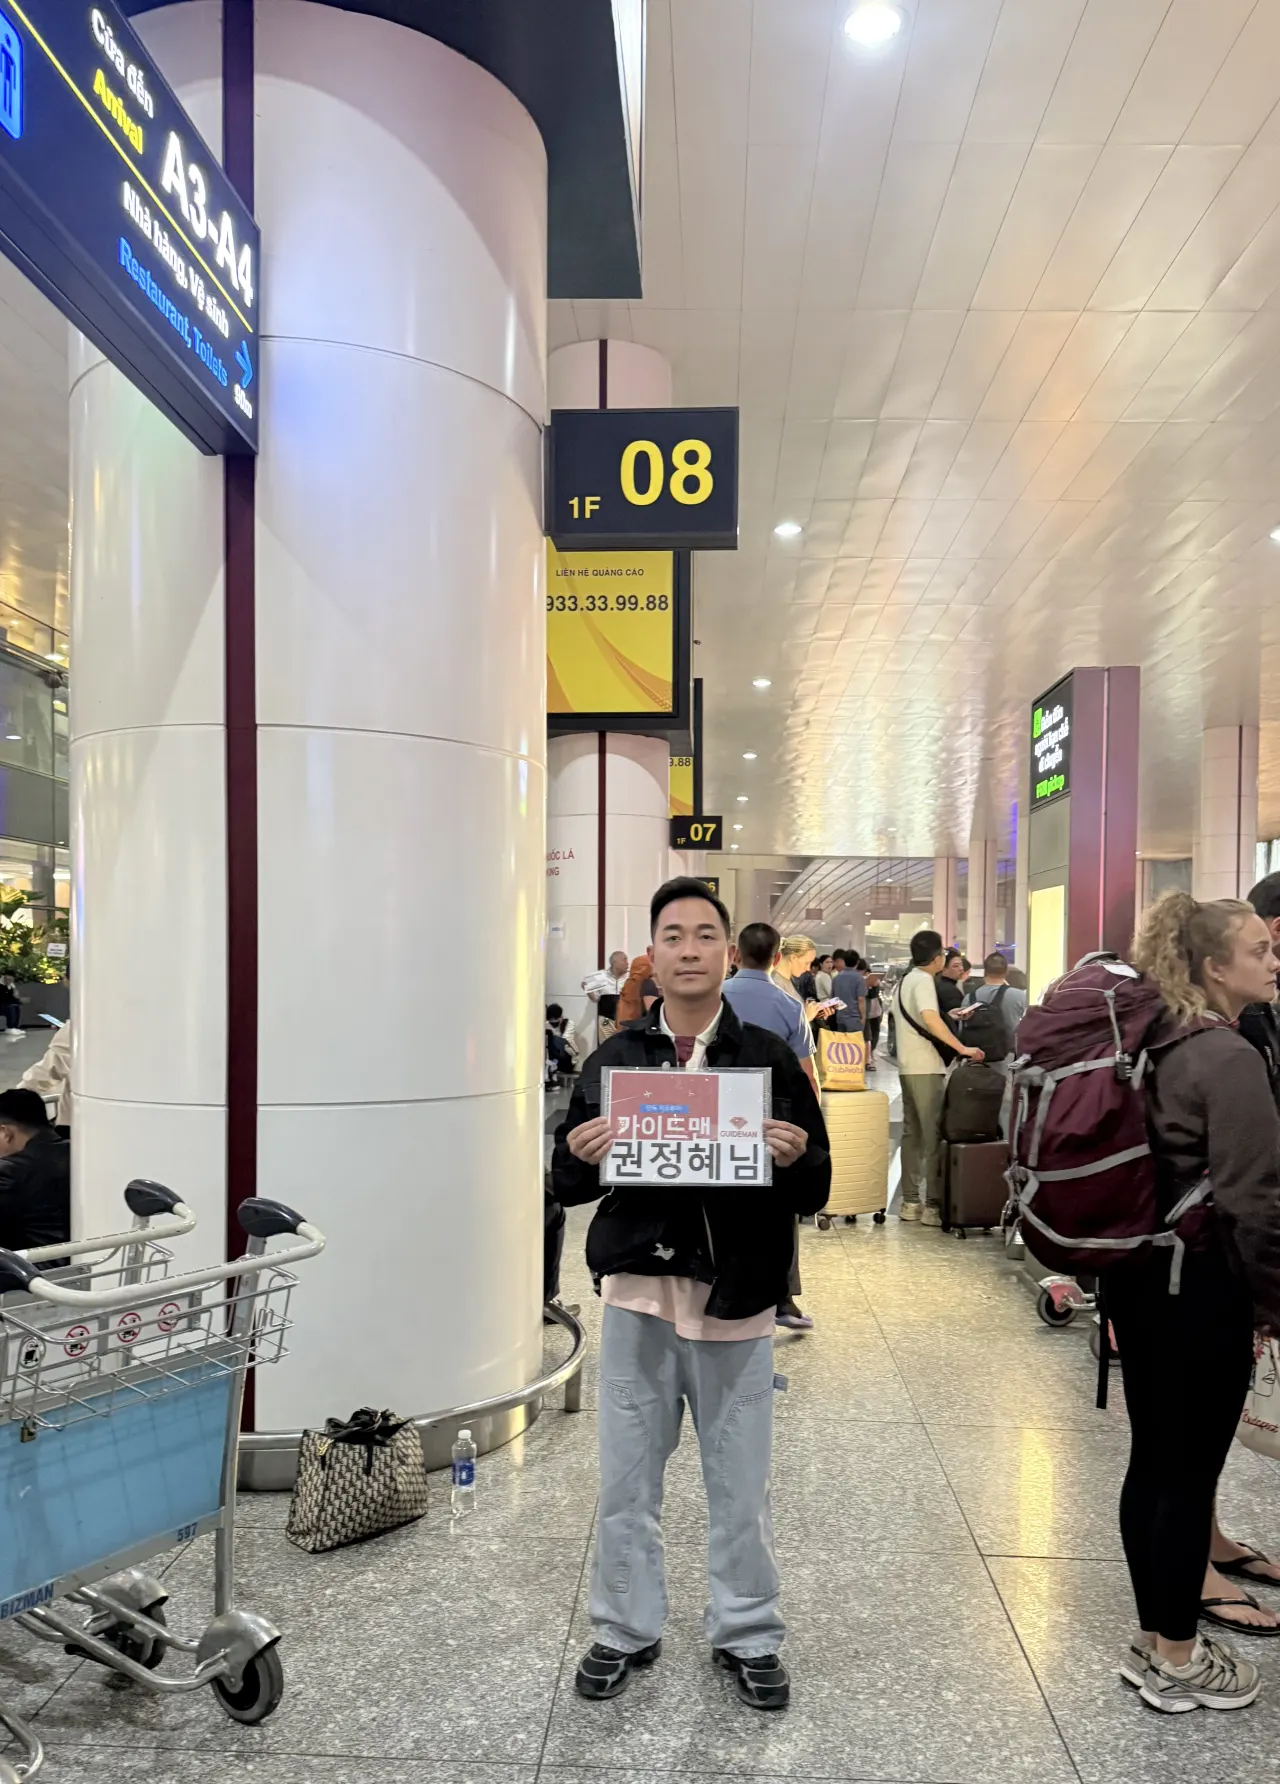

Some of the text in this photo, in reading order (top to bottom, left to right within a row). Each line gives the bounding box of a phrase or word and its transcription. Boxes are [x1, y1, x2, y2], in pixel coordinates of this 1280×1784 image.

[91, 8, 154, 118] Cửa đến
[93, 68, 143, 154] Arrival
[162, 131, 254, 308] A3-A4
[123, 181, 152, 240] Nhà
[206, 293, 229, 338] sinh
[118, 236, 229, 387] Restaurant, Toilets
[620, 439, 714, 506] 08
[568, 496, 601, 519] 1F
[562, 847, 575, 860] LÁ
[689, 823, 717, 842] 07
[611, 1140, 759, 1181] 권정혜님
[720, 1130, 758, 1138] GUIDEMAN
[176, 1522, 198, 1542] 597
